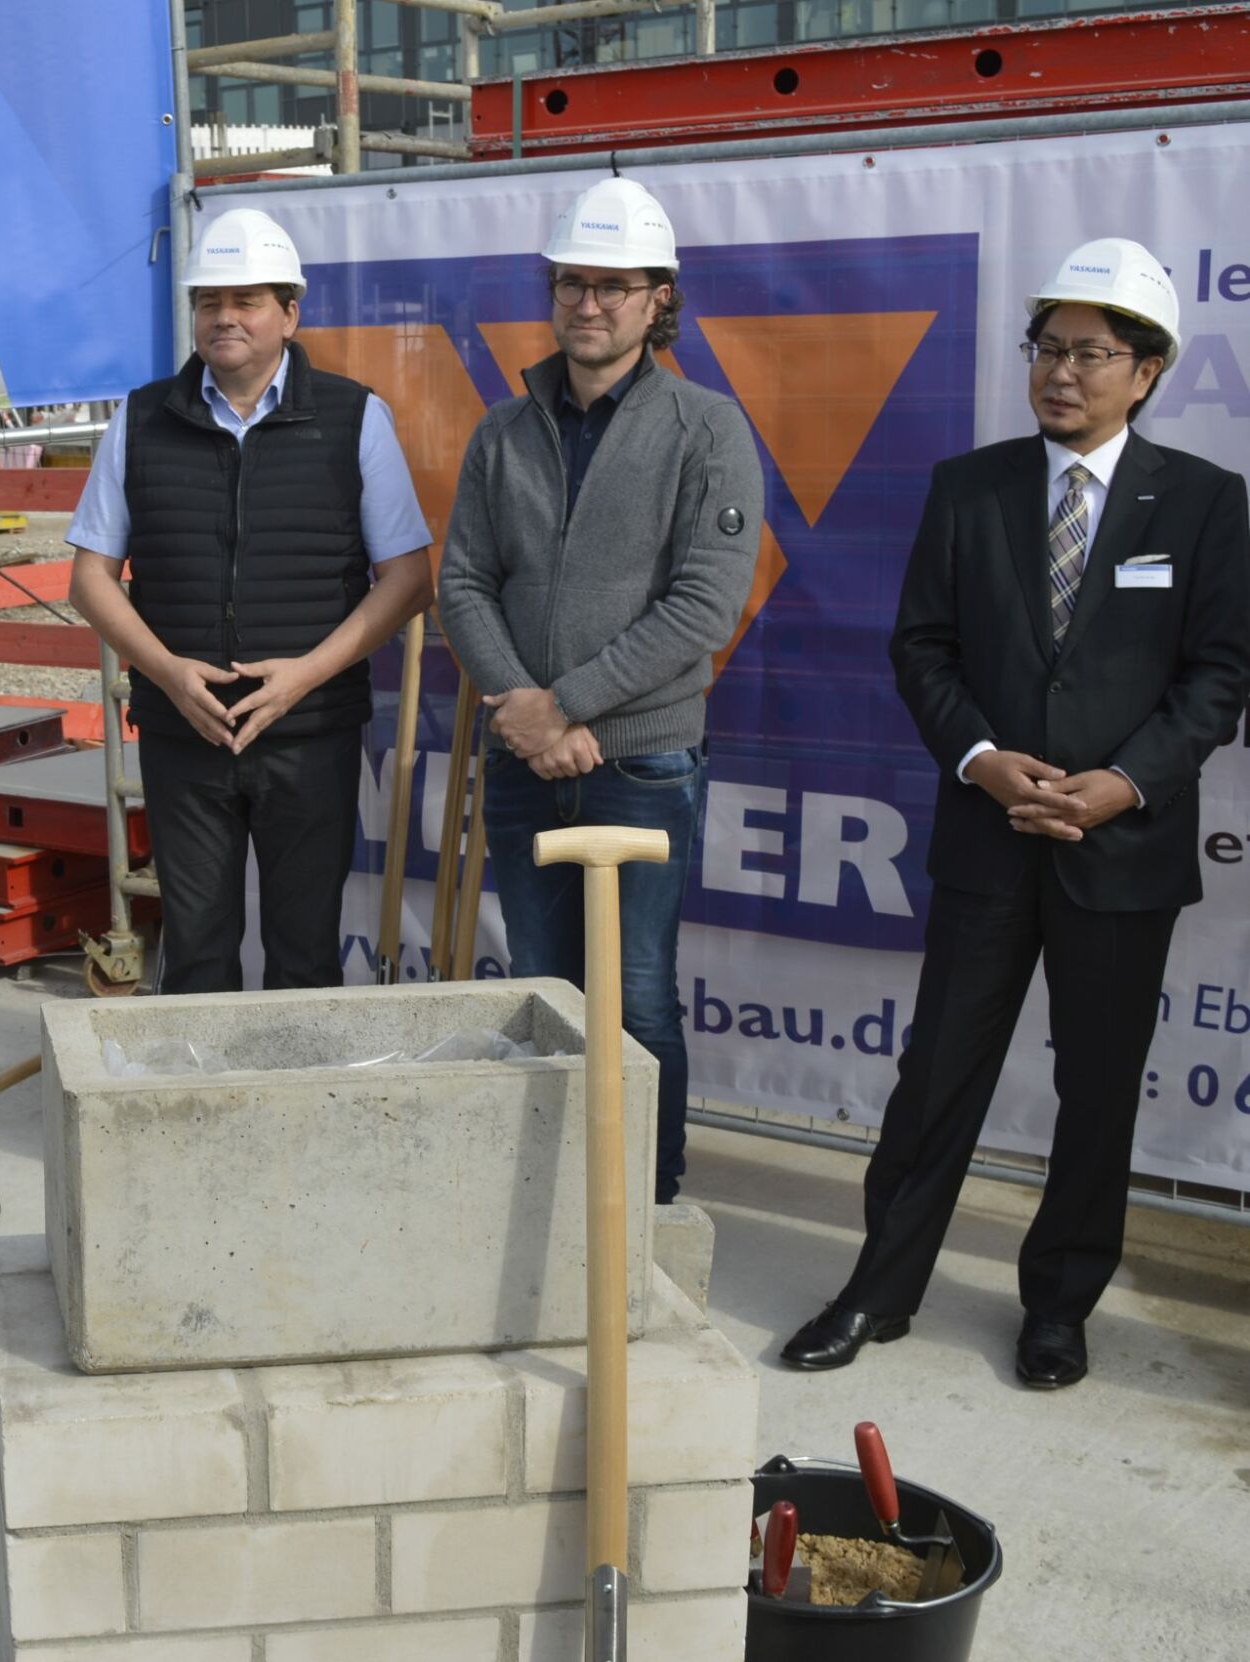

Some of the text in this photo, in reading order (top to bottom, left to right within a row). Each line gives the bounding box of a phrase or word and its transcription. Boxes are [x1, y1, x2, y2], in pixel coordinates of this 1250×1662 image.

[580, 221, 620, 231] YASKAWA
[206, 247, 240, 255] YASKAWA
[1069, 264, 1111, 275] YASKAWA
[680, 976, 914, 1058] bau.d
